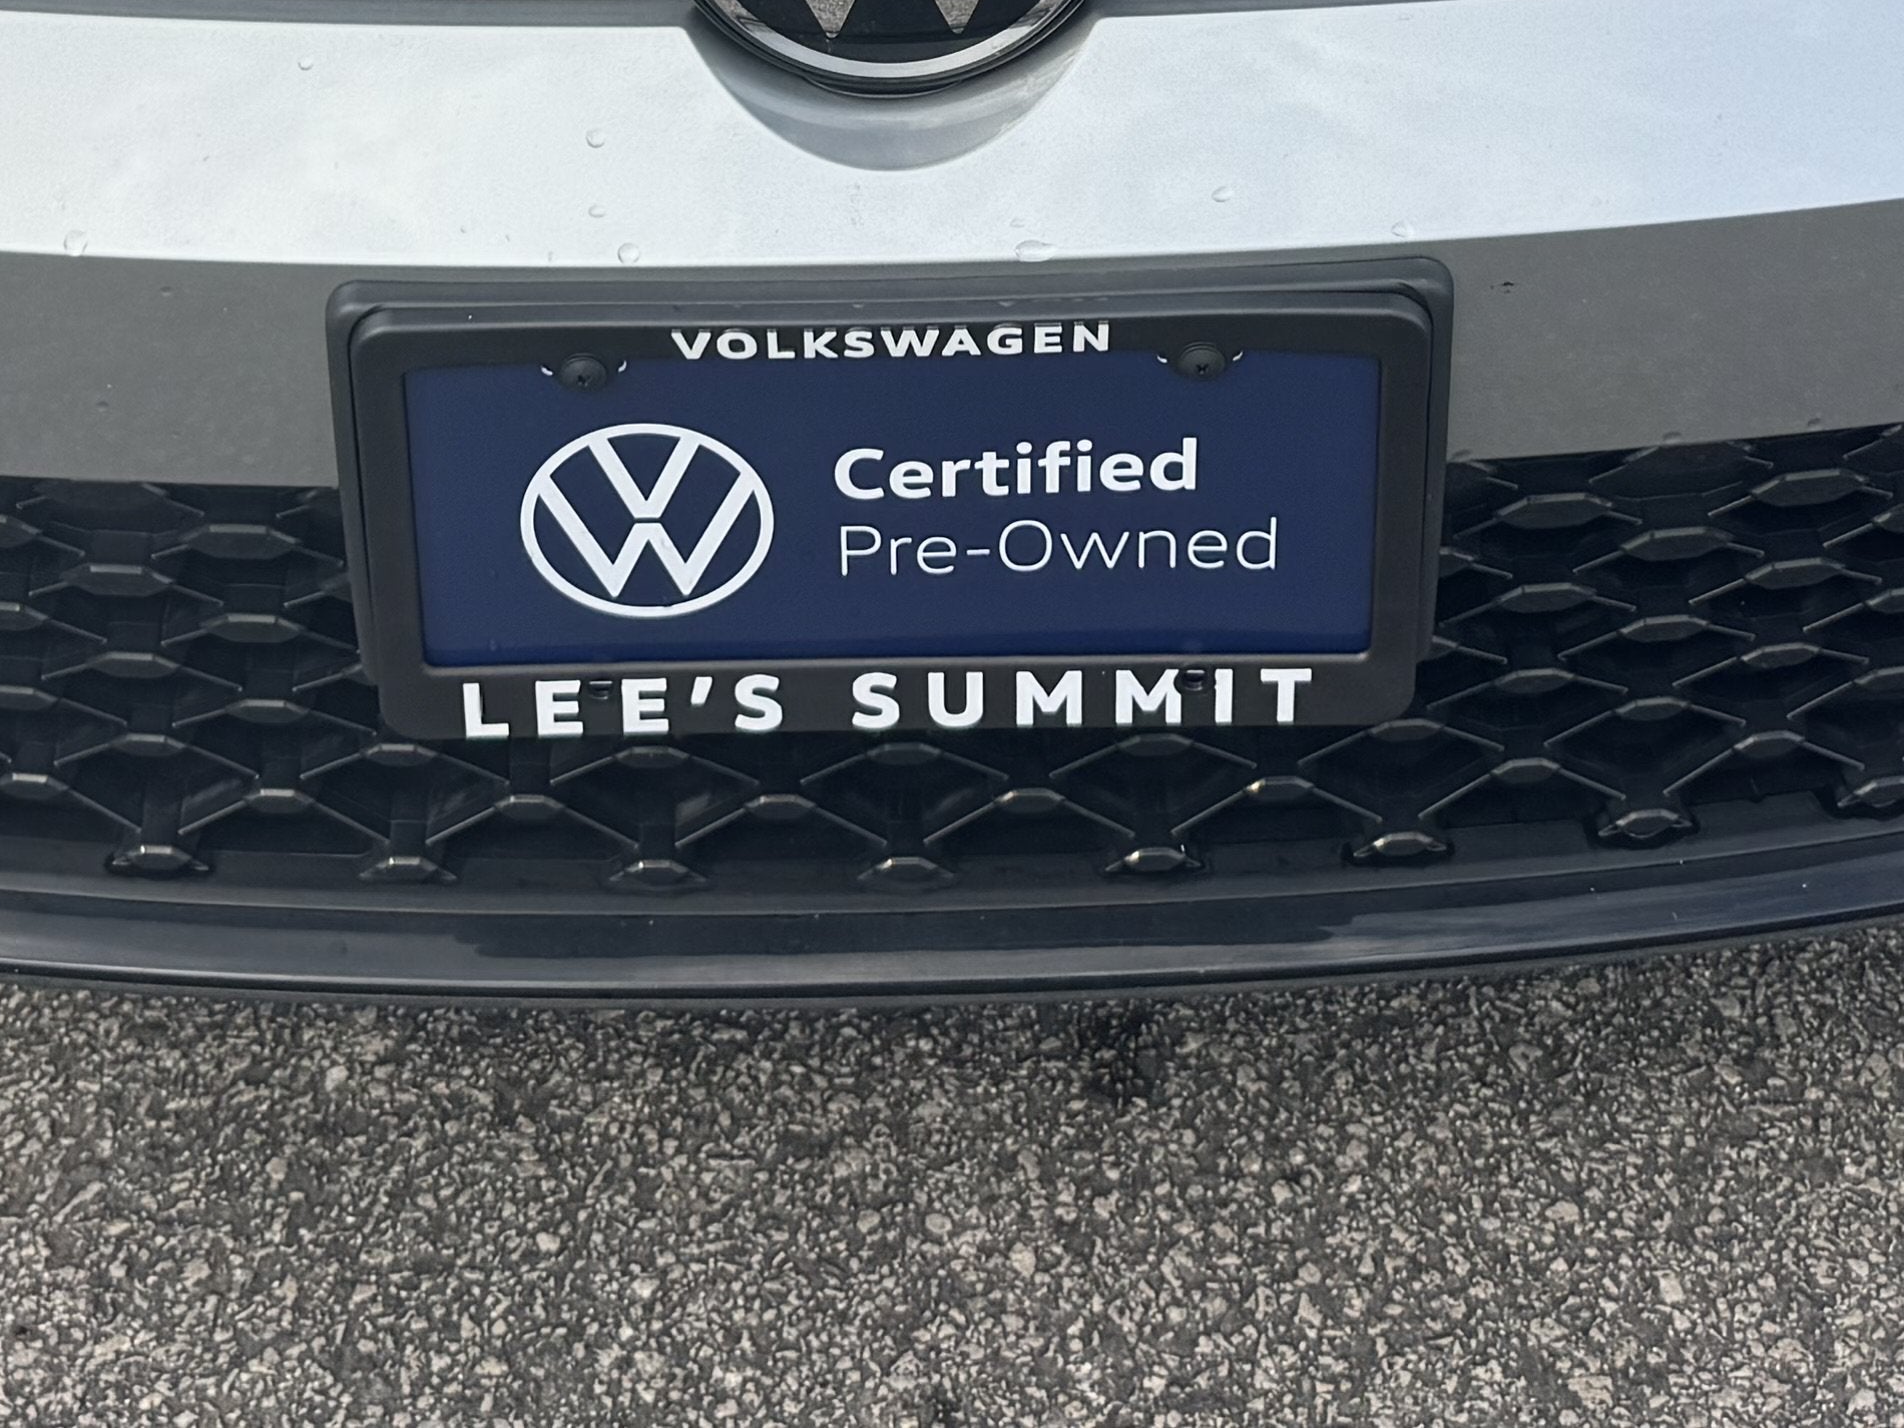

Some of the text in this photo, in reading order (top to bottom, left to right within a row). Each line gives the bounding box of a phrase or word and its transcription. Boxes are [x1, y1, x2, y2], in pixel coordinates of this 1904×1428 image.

[671, 320, 1111, 361] VOLKSWAGEN
[833, 437, 1199, 502] Certified
[520, 421, 775, 619] VW
[838, 515, 1279, 578] Pre-Owned
[462, 667, 1314, 739] LEE'S SUMMIT
